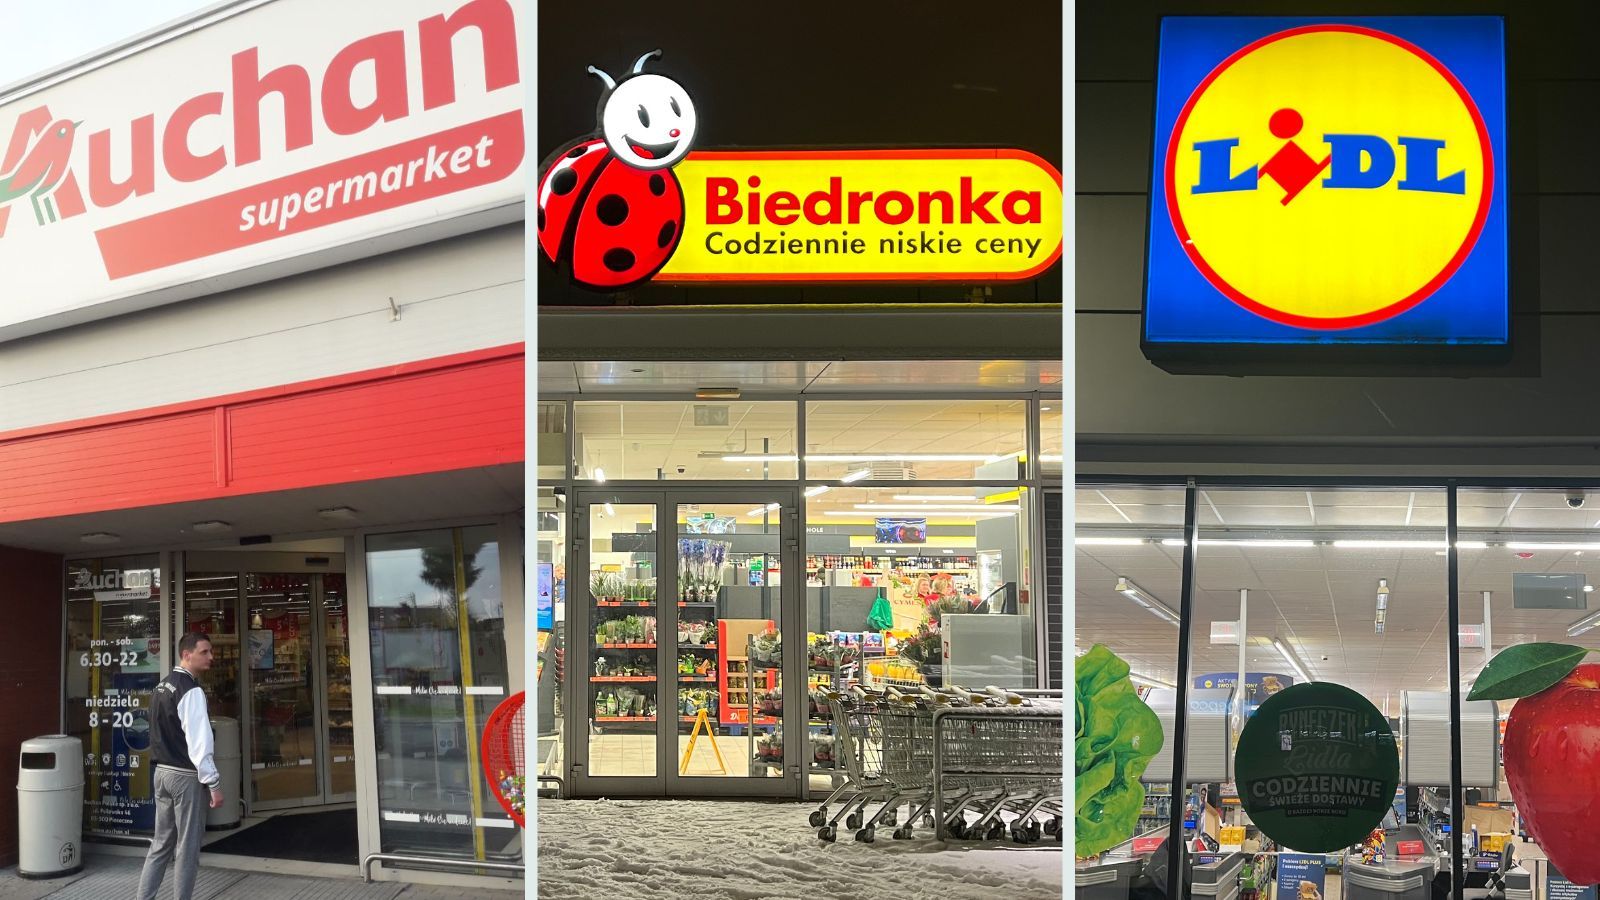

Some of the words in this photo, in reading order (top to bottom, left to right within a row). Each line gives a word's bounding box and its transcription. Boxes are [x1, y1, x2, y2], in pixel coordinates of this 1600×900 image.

[0, 0, 521, 238] Auchan
[239, 135, 493, 233] supermarket
[705, 175, 1042, 225] Biedronka
[704, 230, 866, 255] Codziennie
[879, 230, 962, 255] niskie
[975, 237, 1043, 258] ceny
[90, 639, 109, 649] pon.
[115, 636, 134, 646] sob.
[80, 651, 138, 667] 6.30-22
[85, 695, 140, 707] niedziela
[88, 711, 99, 728] 8
[112, 711, 134, 728] 20
[1252, 775, 1383, 798] CODZIENNIE
[1312, 793, 1366, 807] DOSTAWY
